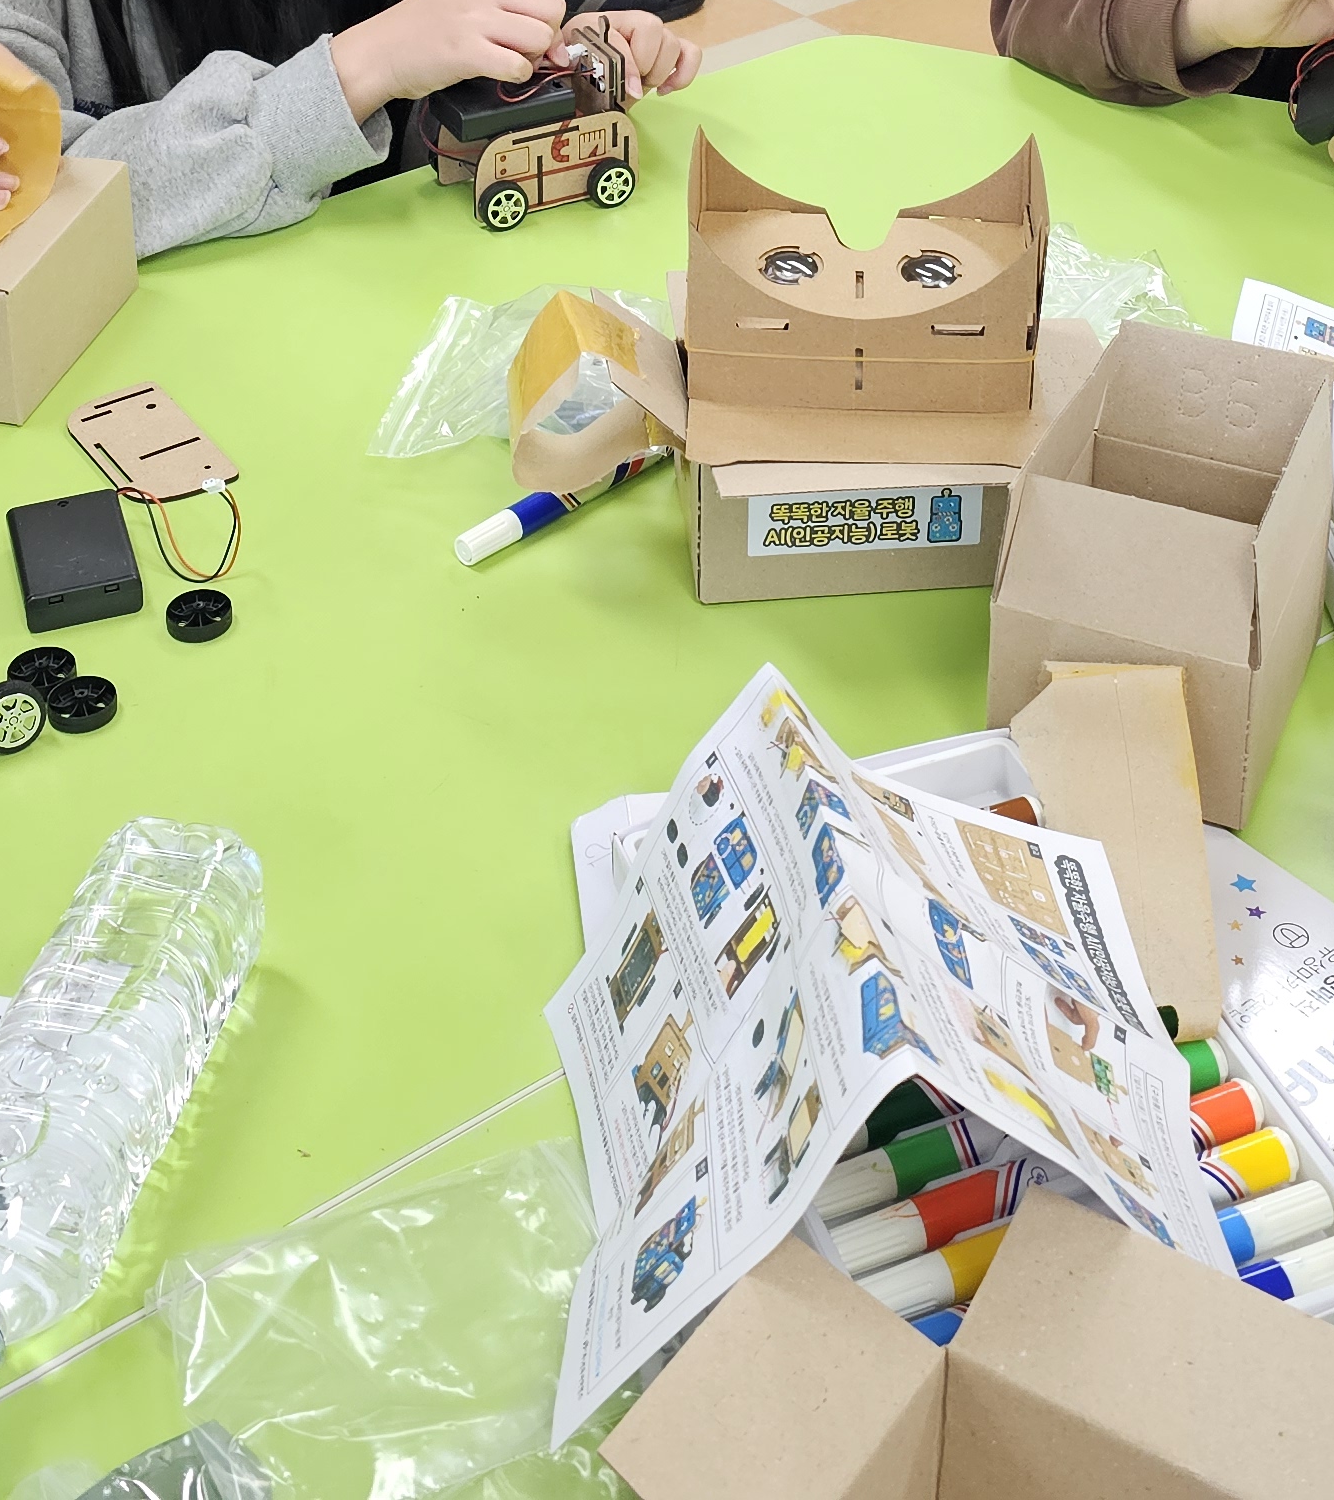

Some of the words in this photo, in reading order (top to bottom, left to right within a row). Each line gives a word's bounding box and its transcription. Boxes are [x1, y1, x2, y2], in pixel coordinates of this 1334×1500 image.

[770, 502, 830, 524] 똑똑한
[831, 499, 871, 521] 자율
[875, 497, 915, 520] 주행
[764, 522, 877, 547] AI(인공지능)
[879, 520, 919, 542] 로봇
